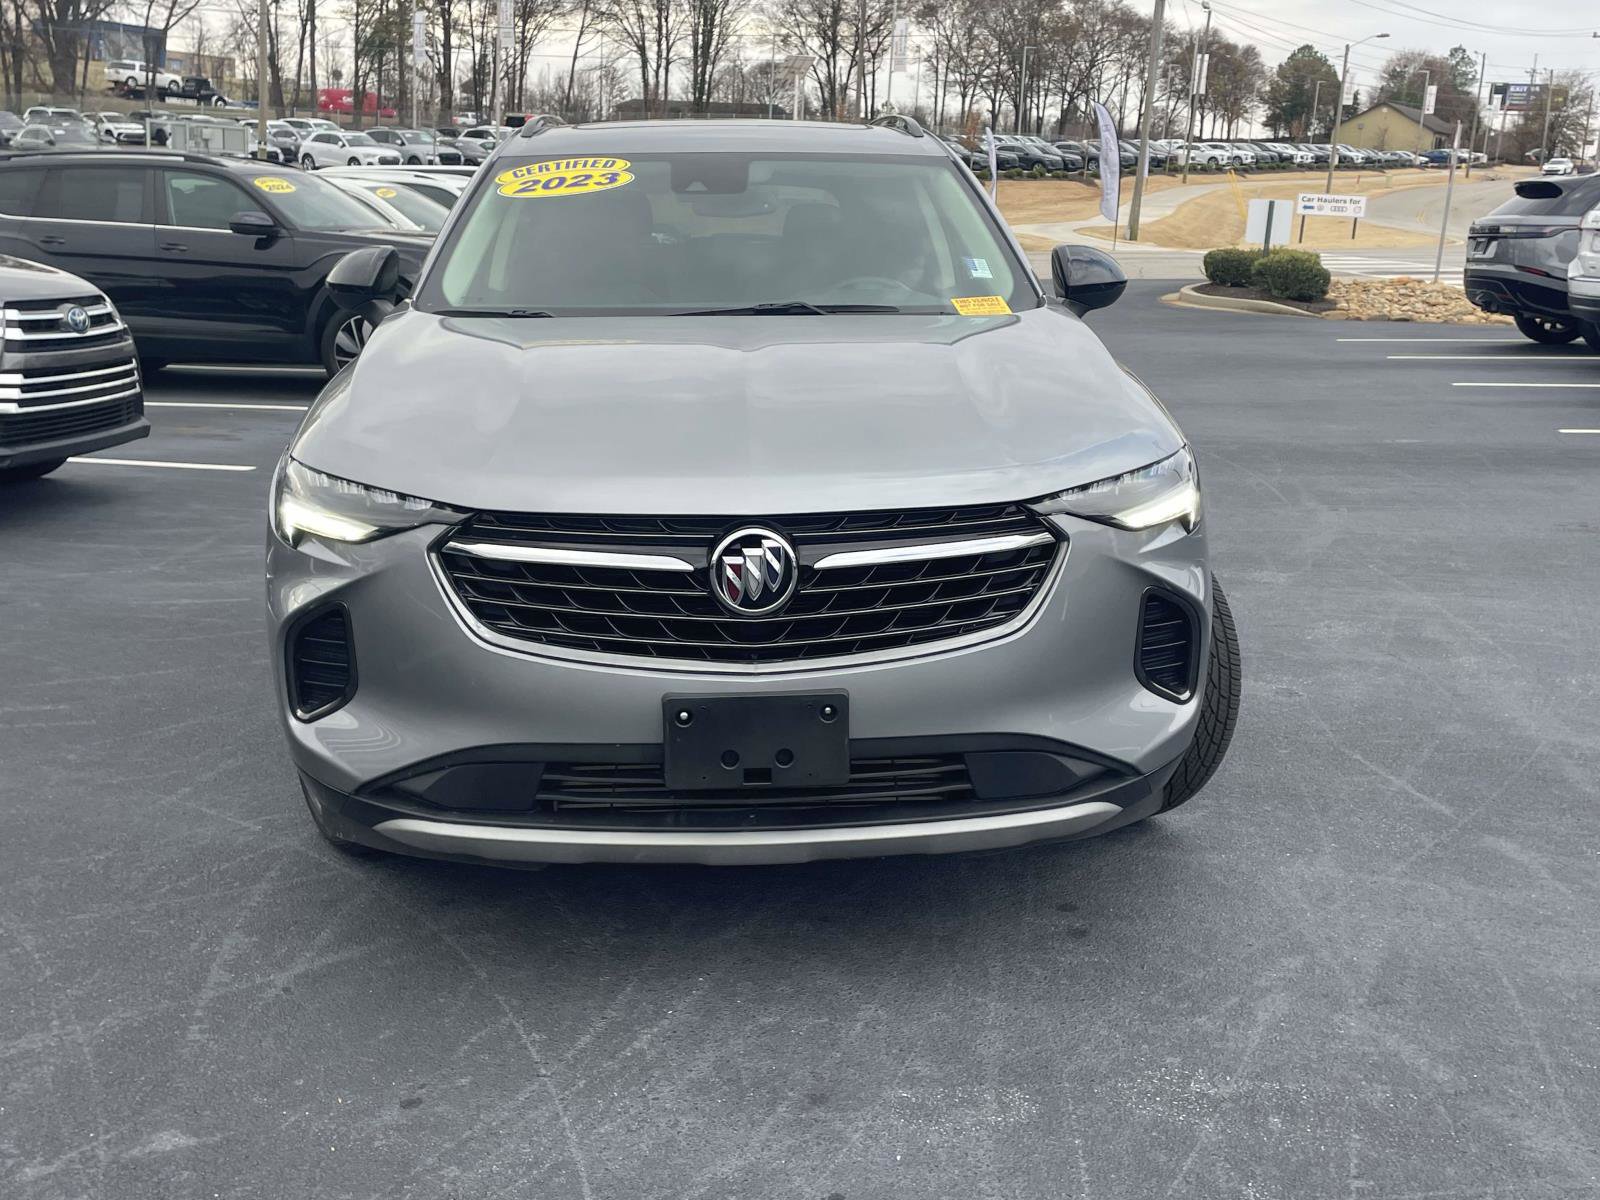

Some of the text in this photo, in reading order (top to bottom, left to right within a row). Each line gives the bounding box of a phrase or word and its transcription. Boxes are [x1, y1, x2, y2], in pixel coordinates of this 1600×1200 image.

[512, 159, 617, 179] CERTIFIED
[512, 172, 620, 194] 2023
[1317, 196, 1347, 205] Haulers
